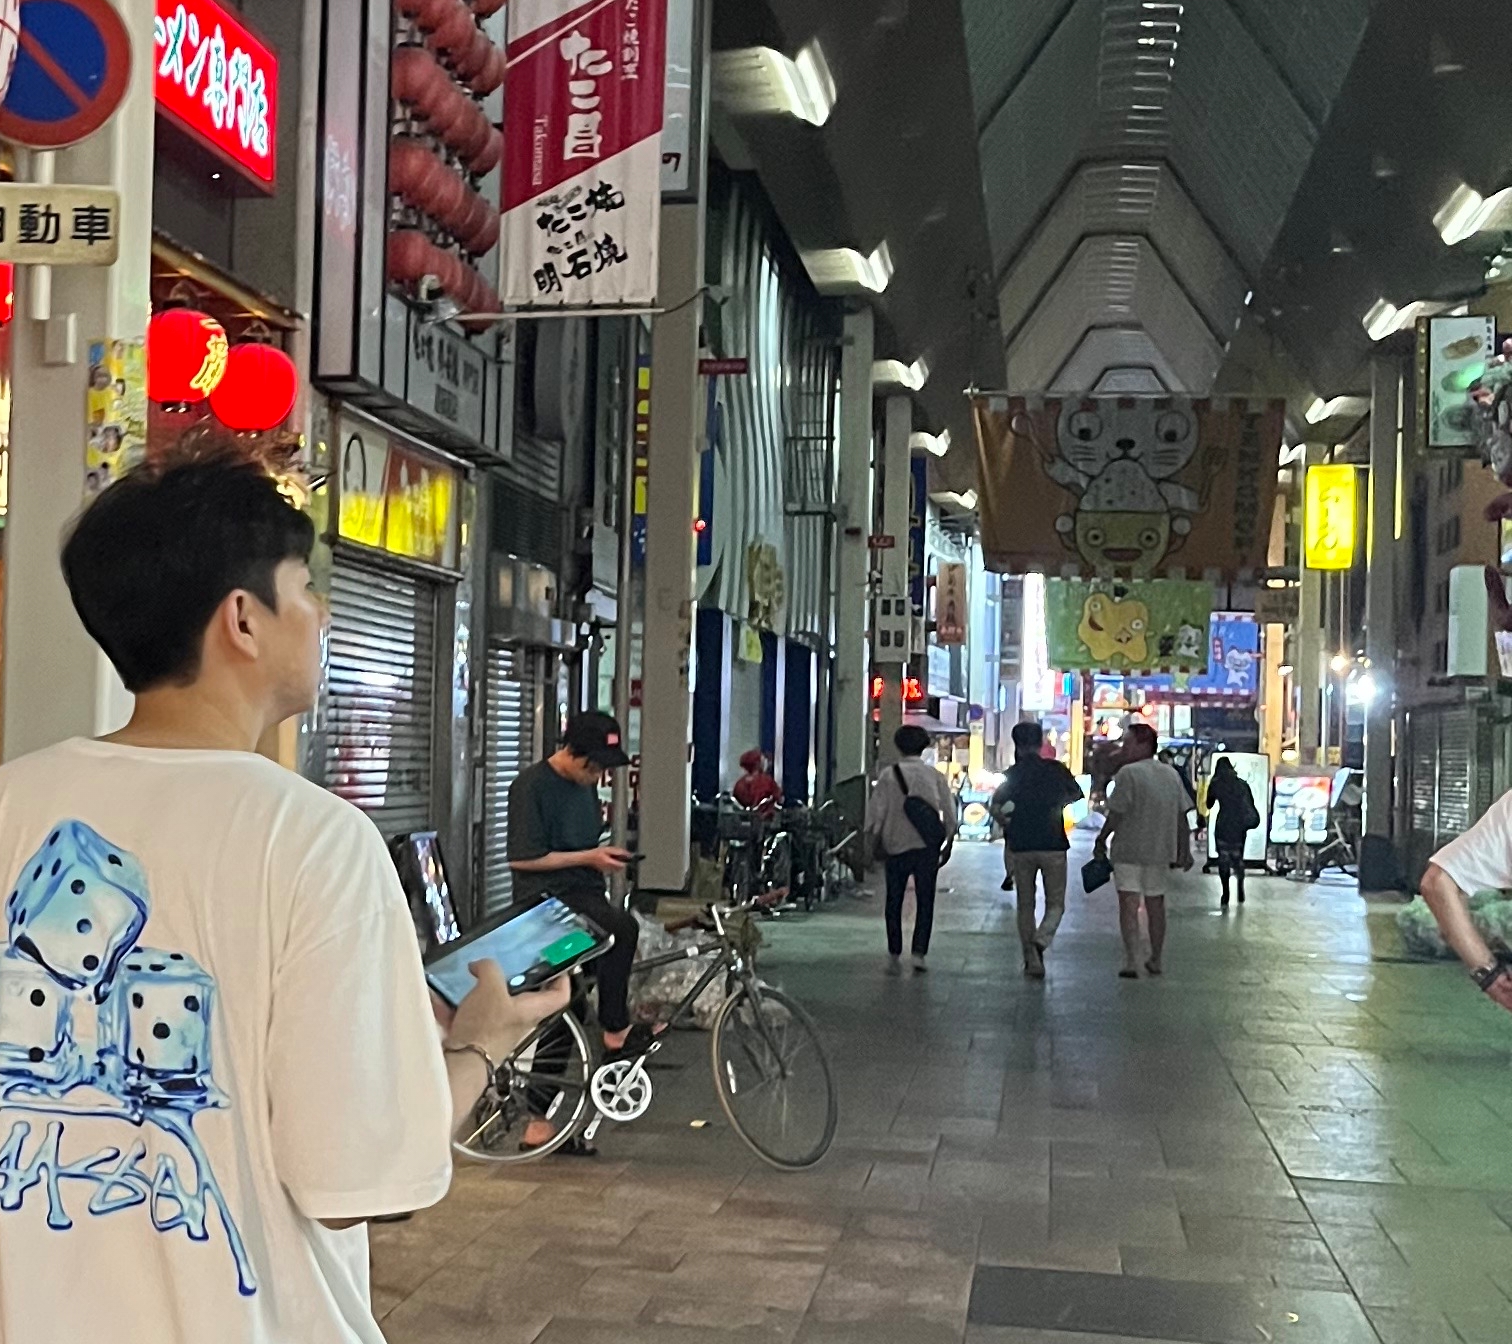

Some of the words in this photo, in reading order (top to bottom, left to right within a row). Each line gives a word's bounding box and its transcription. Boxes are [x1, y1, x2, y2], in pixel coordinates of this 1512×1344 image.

[558, 29, 614, 162] たこ昌
[536, 179, 626, 238] たこ焼
[533, 232, 629, 294] 明石焼
